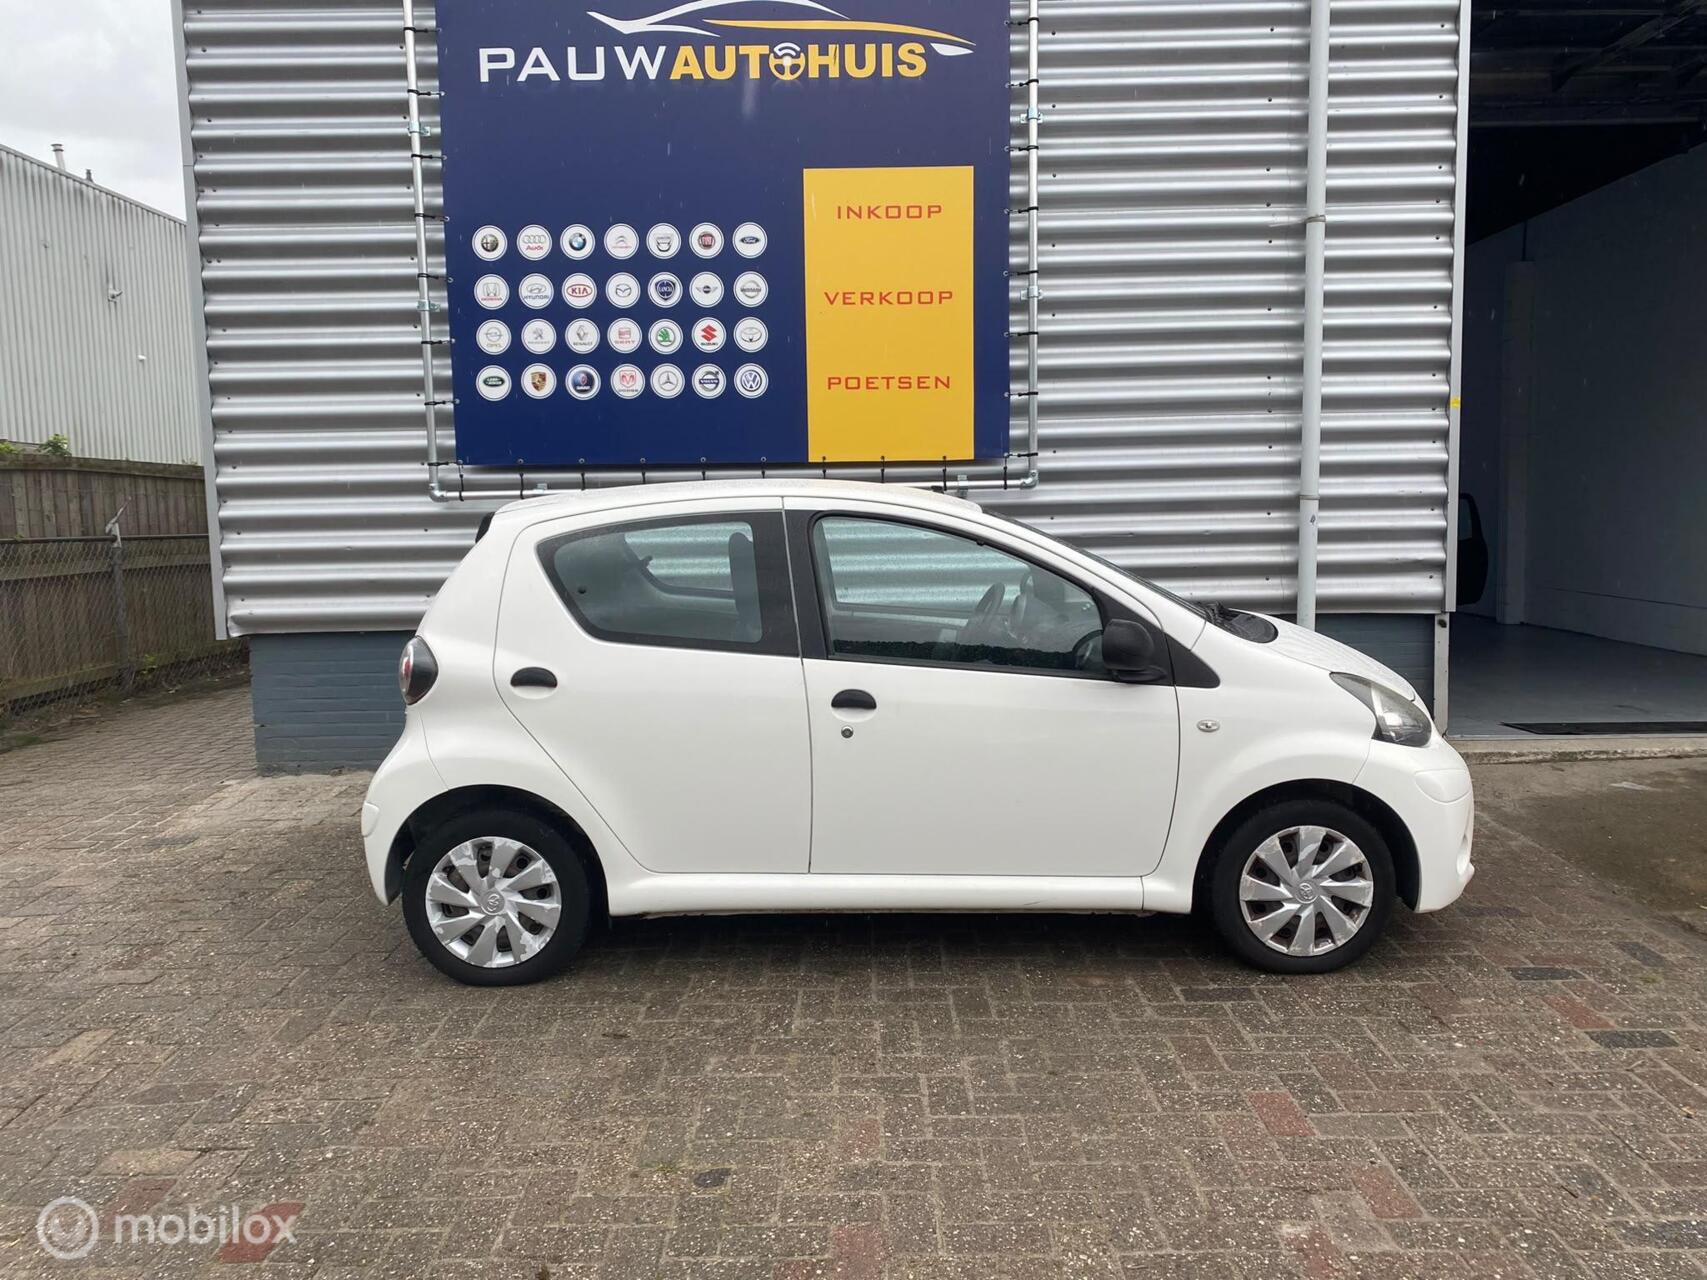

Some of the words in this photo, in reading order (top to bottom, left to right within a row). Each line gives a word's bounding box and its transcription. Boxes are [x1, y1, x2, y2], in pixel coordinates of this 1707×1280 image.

[837, 204, 943, 219] INKOOP
[570, 287, 589, 295] KIA
[824, 291, 953, 305] VERKOOP
[827, 375, 951, 390] POETSEN
